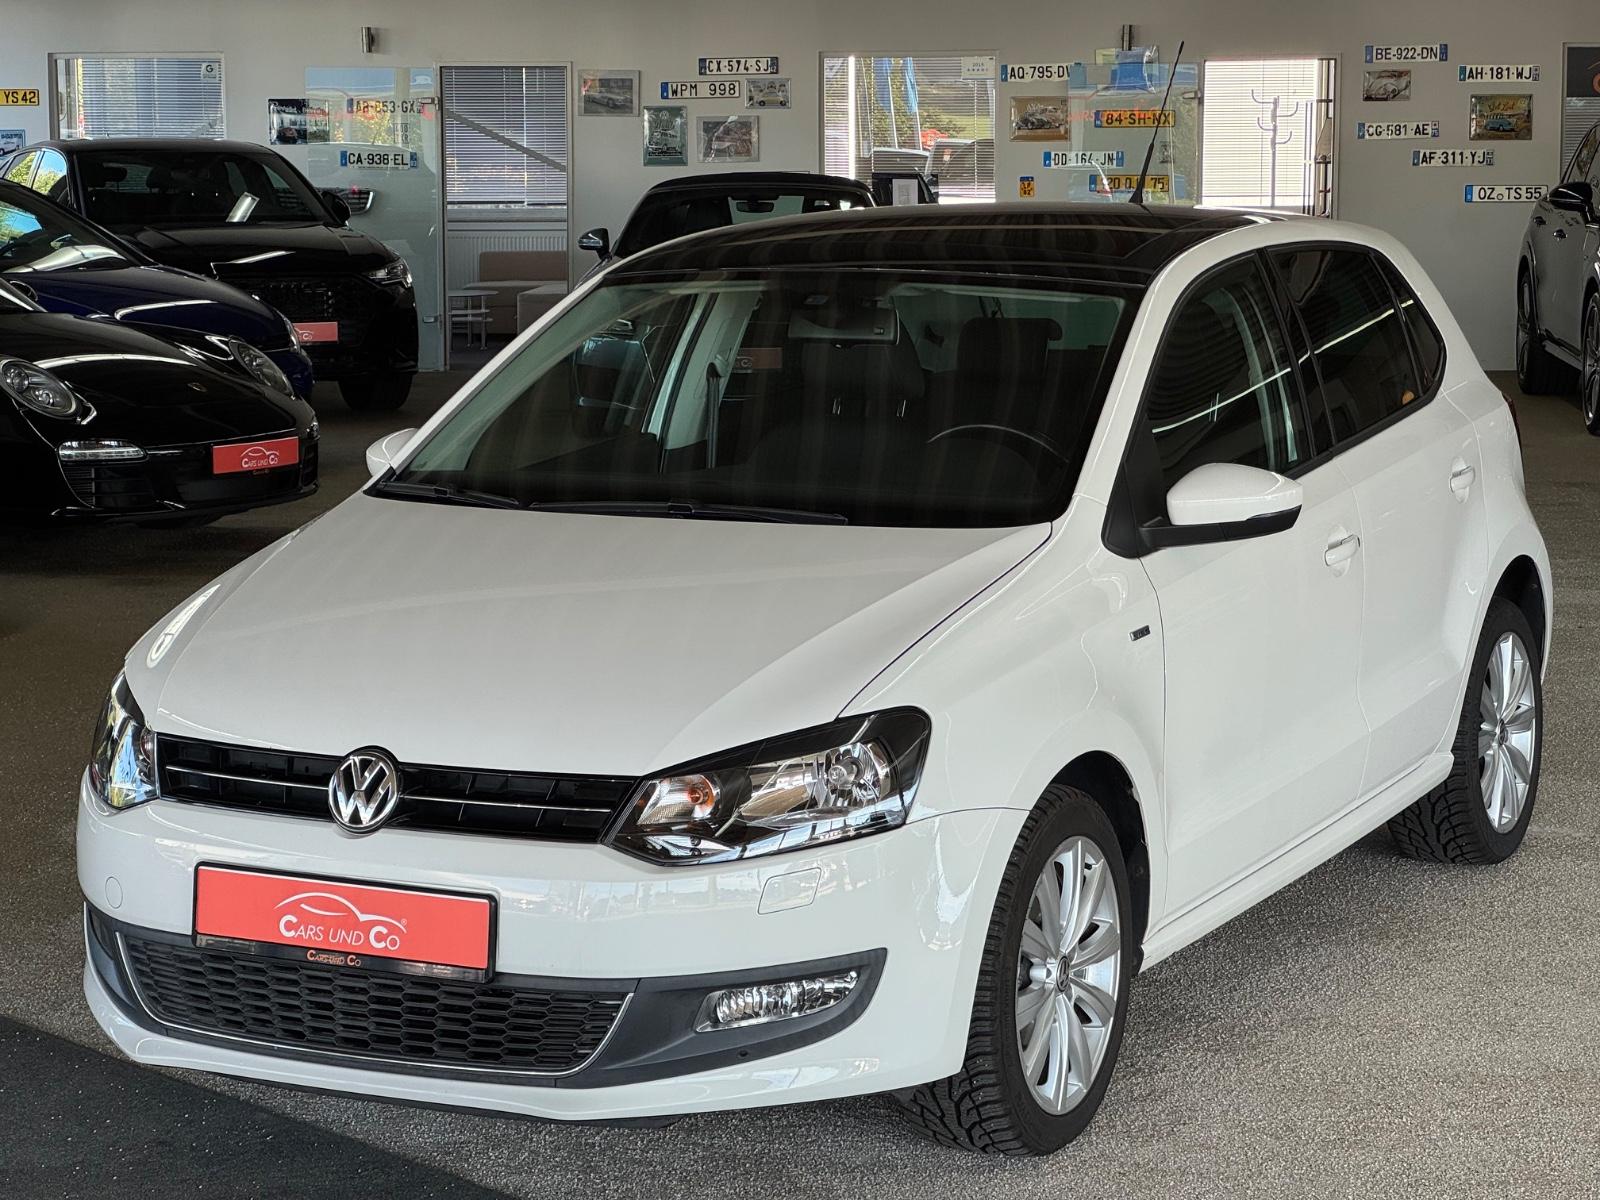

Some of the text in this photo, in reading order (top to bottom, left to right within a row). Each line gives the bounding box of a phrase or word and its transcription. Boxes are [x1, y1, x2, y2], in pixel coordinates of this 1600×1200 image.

[1375, 46, 1438, 60] BE-922-DN
[707, 59, 769, 73] CX-574-SJ
[1467, 66, 1532, 80] AH-181-WJ
[670, 83, 736, 97] WPM 998
[1105, 112, 1171, 125] 84-SH-NX
[1366, 123, 1430, 137] CG-581-AE
[348, 152, 409, 166] CA-938-EL
[1053, 152, 1114, 166] DD-164-JN
[1420, 151, 1486, 165] AF-311-YJ
[1478, 186, 1496, 200] OZ
[1525, 186, 1542, 200] 55
[328, 927, 365, 946] UND
